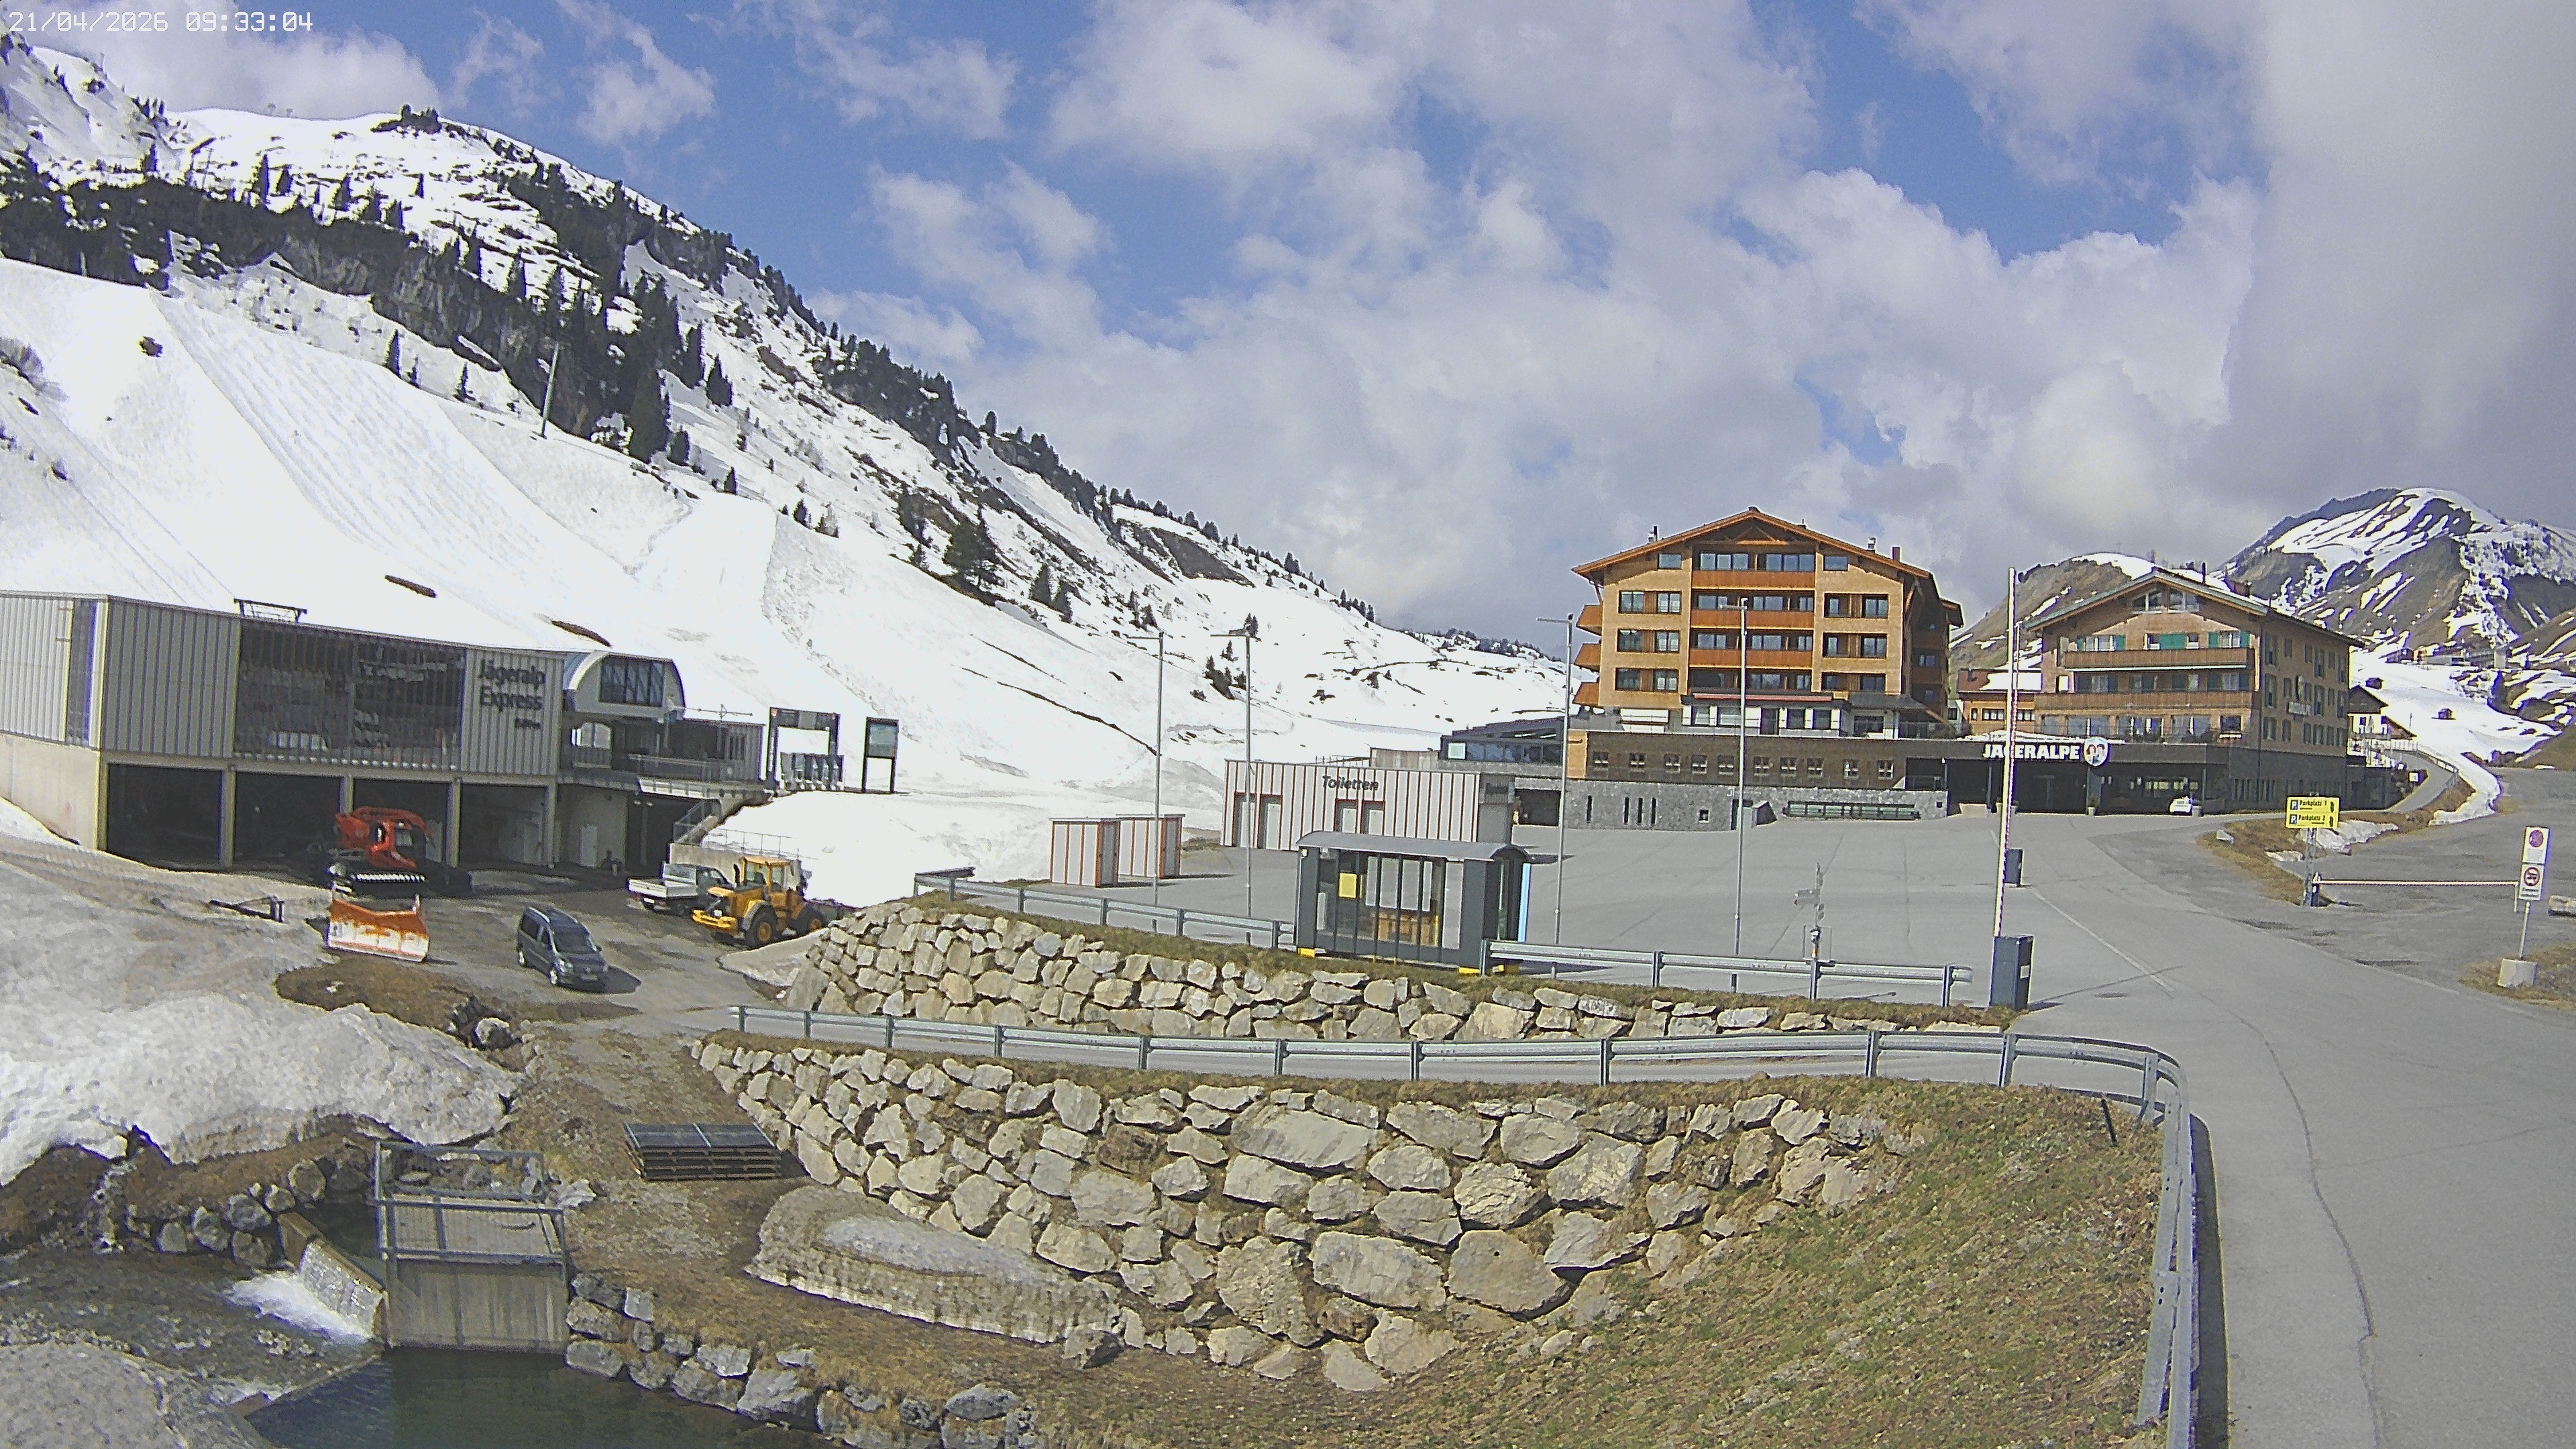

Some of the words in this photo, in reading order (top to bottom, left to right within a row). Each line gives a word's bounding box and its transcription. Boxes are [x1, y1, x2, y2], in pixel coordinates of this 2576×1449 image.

[478, 659, 546, 690] Jägeralp
[480, 686, 542, 712] Express
[1322, 775, 1379, 790] Toiletten
